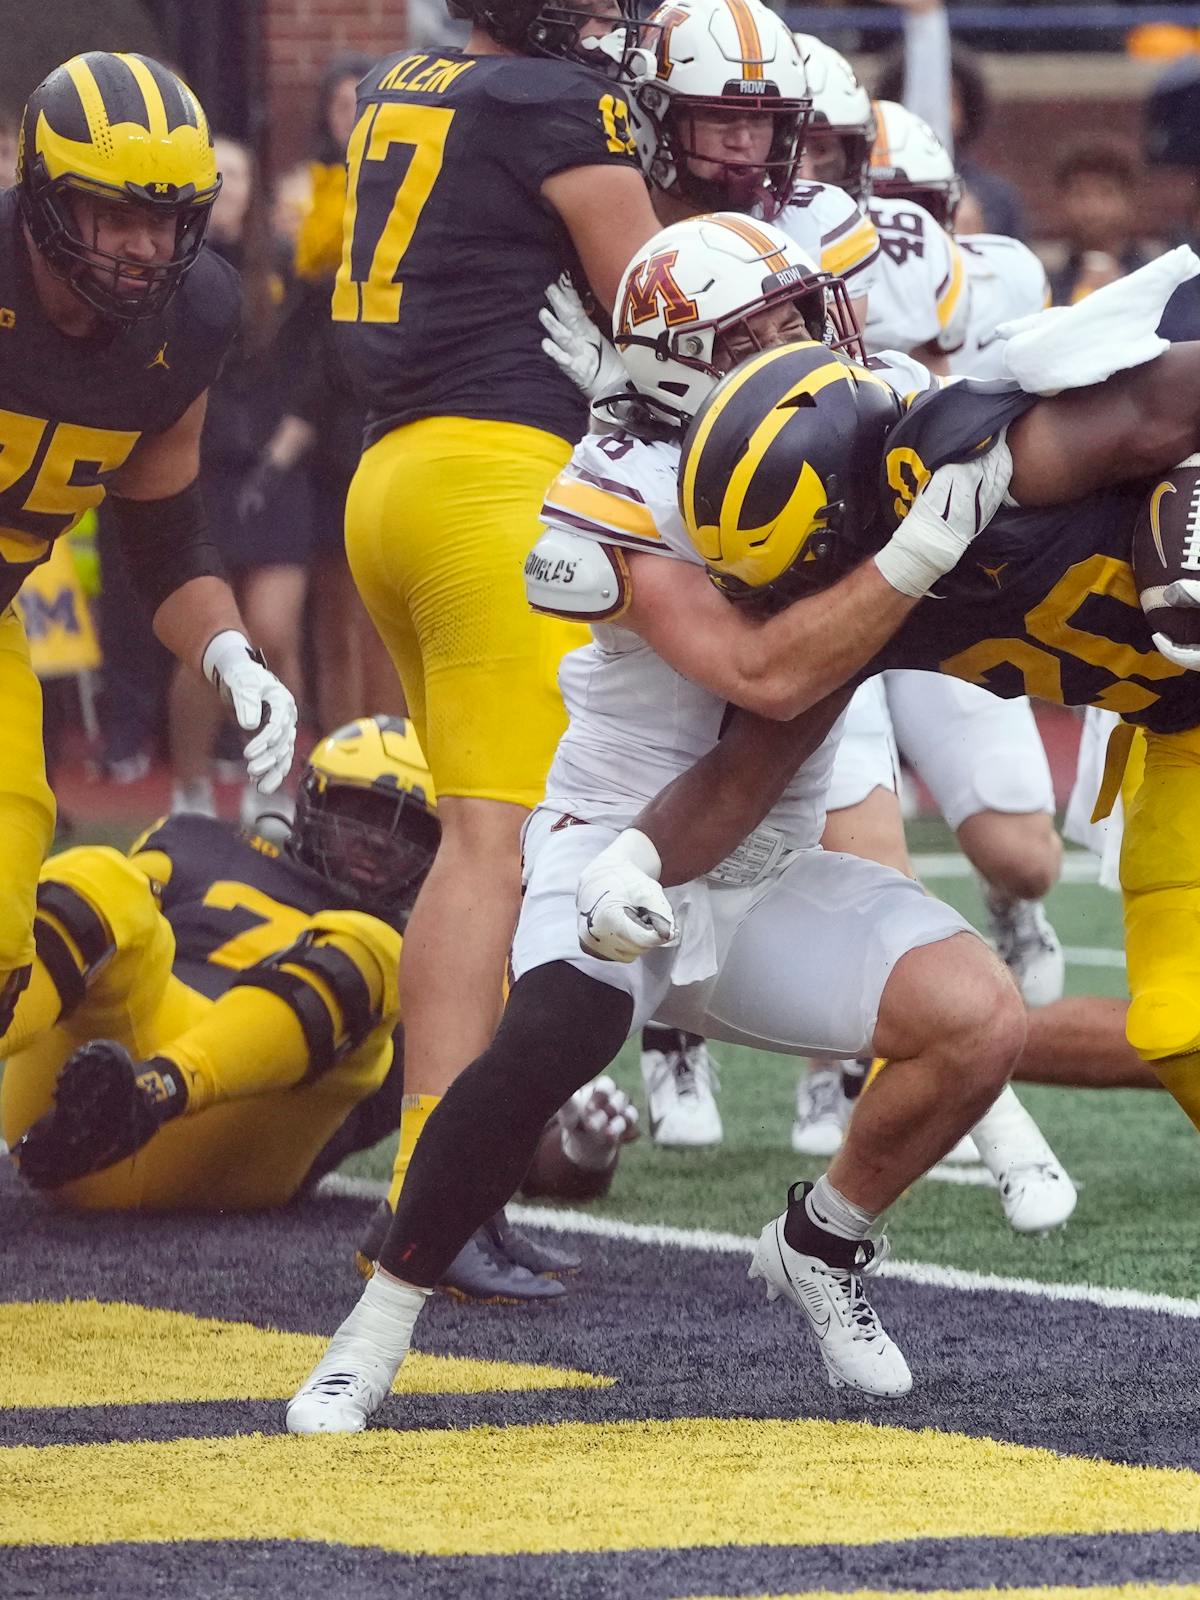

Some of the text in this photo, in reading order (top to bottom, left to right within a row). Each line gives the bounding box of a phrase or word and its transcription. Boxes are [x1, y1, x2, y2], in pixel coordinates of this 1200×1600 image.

[378, 54, 477, 94] KLEIN
[739, 79, 767, 95] ROW
[331, 102, 457, 324] 17
[775, 266, 802, 287] ROW
[616, 249, 700, 353] M
